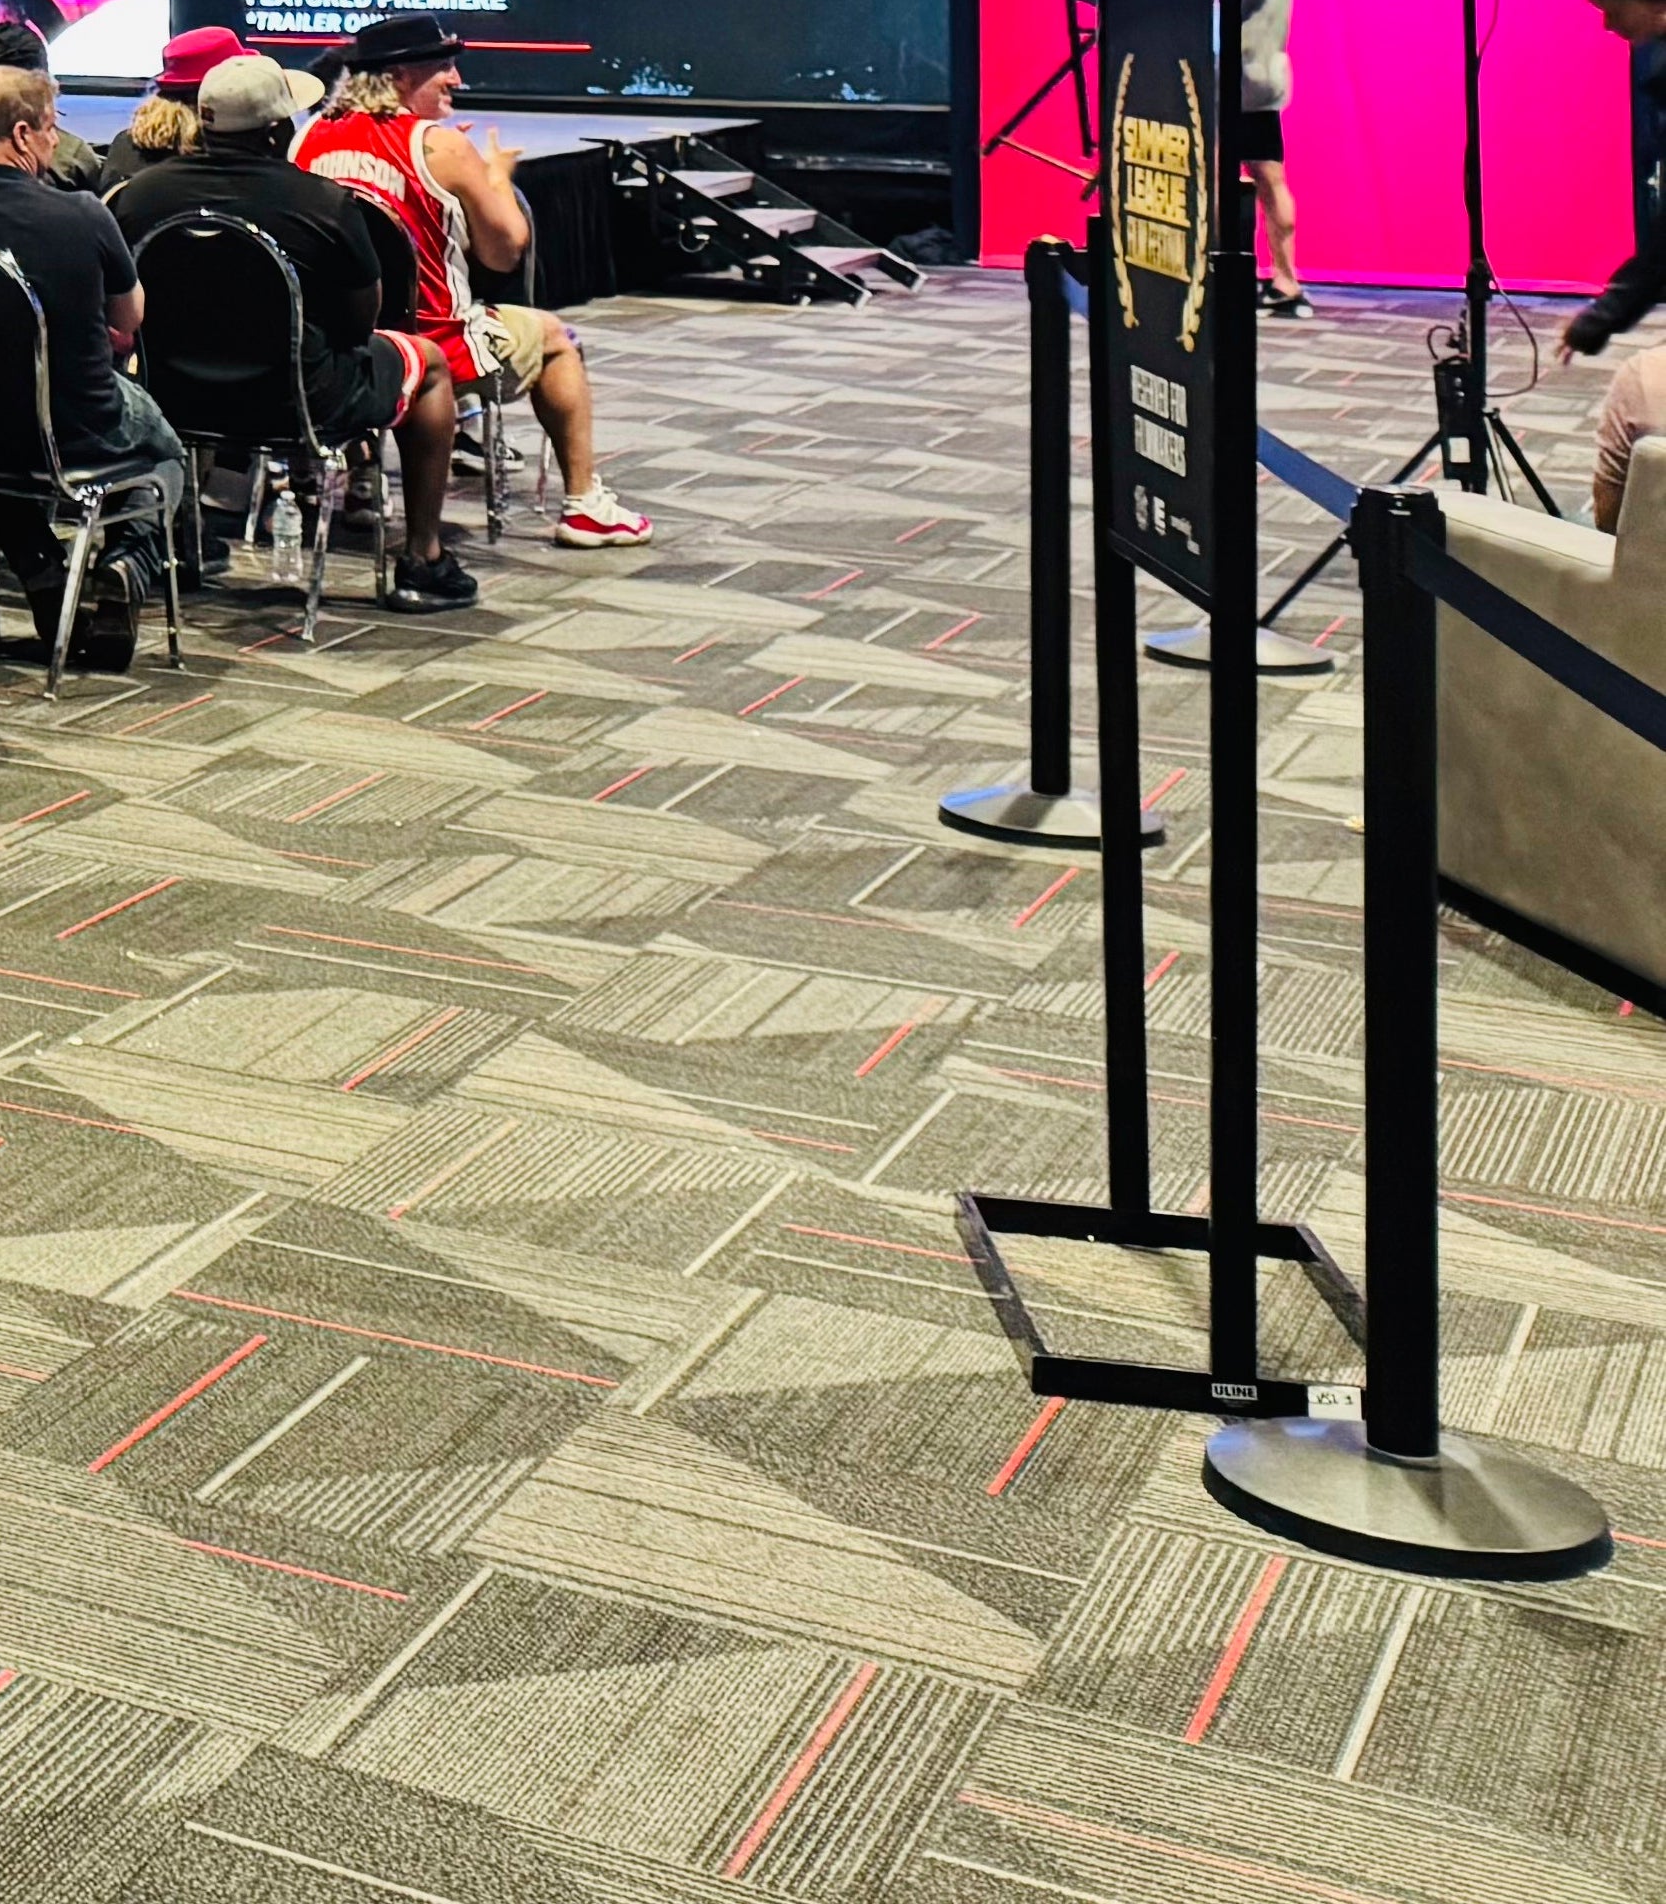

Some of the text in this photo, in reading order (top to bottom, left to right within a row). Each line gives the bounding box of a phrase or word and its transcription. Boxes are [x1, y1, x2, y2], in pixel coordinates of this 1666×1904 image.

[1123, 116, 1190, 177] SUMMER
[1125, 165, 1190, 227] LEAGUE
[1214, 1384, 1257, 1399] ULINE
